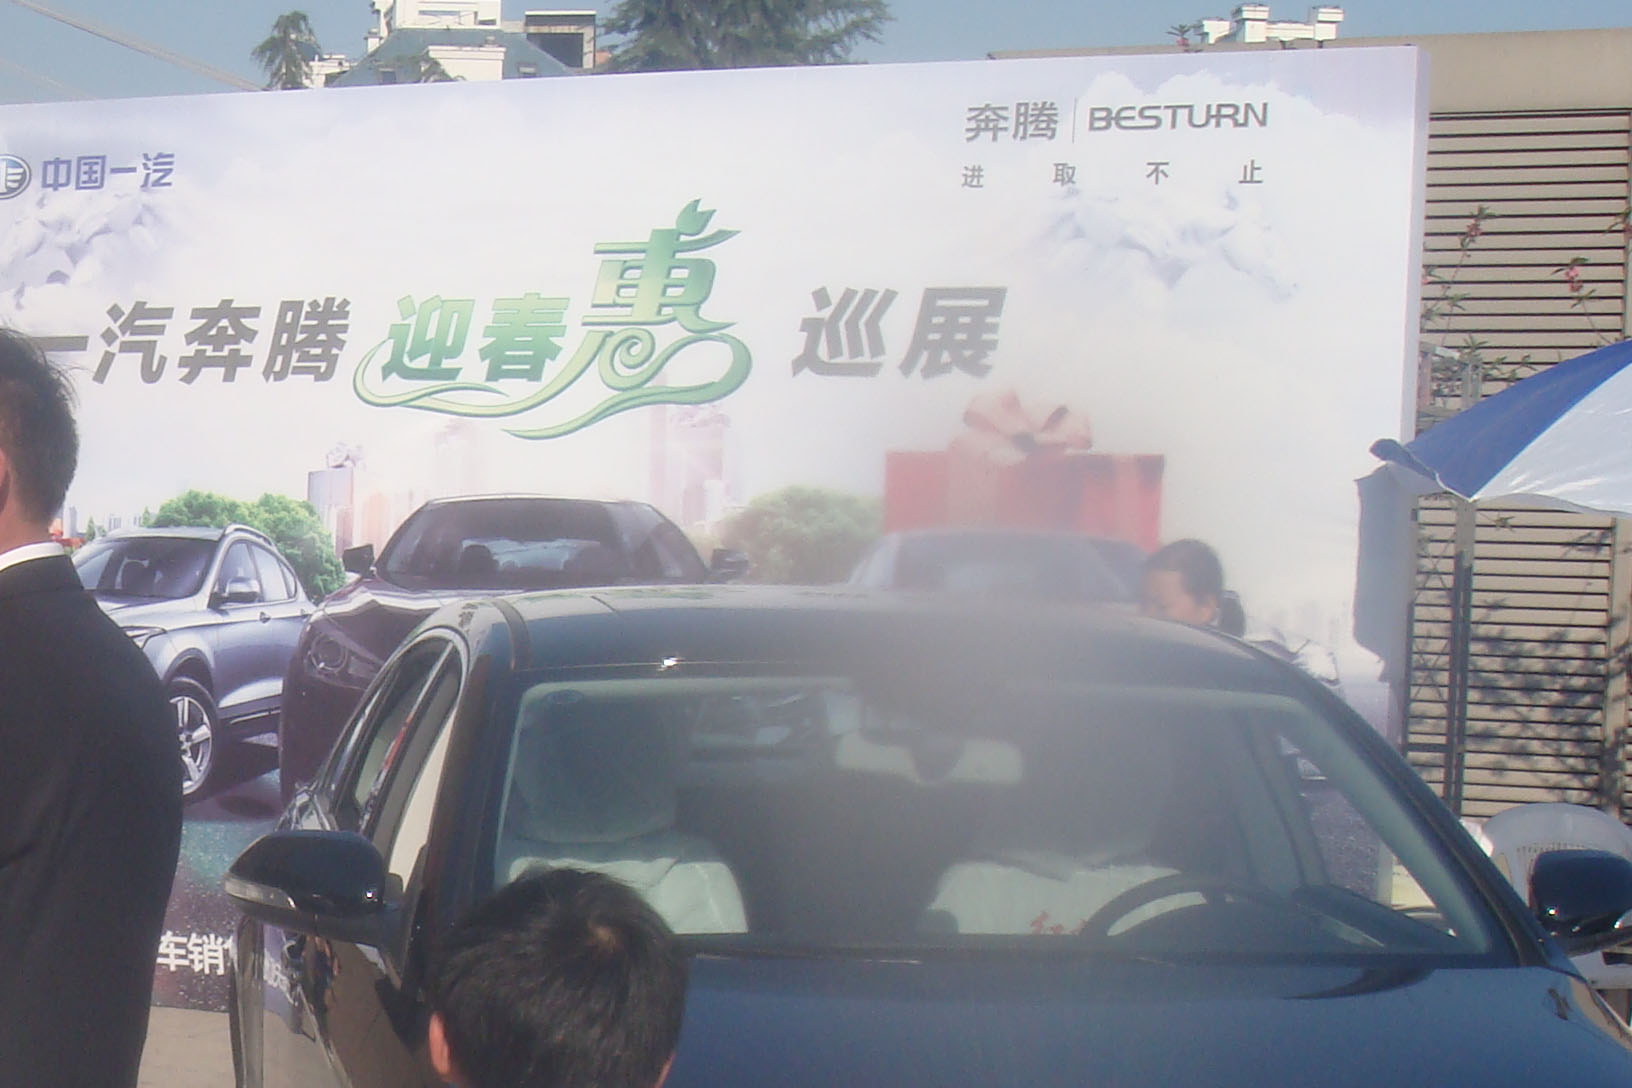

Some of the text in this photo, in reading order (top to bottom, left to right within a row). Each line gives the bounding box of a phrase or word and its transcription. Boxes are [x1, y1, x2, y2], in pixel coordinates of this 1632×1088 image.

[965, 101, 1268, 142] 奔腾 BESTURN
[41, 152, 175, 191] 中国一汽
[32, 297, 351, 385] 一汽奔腾
[791, 286, 1008, 380] 巡展
[156, 931, 236, 975] 车销
